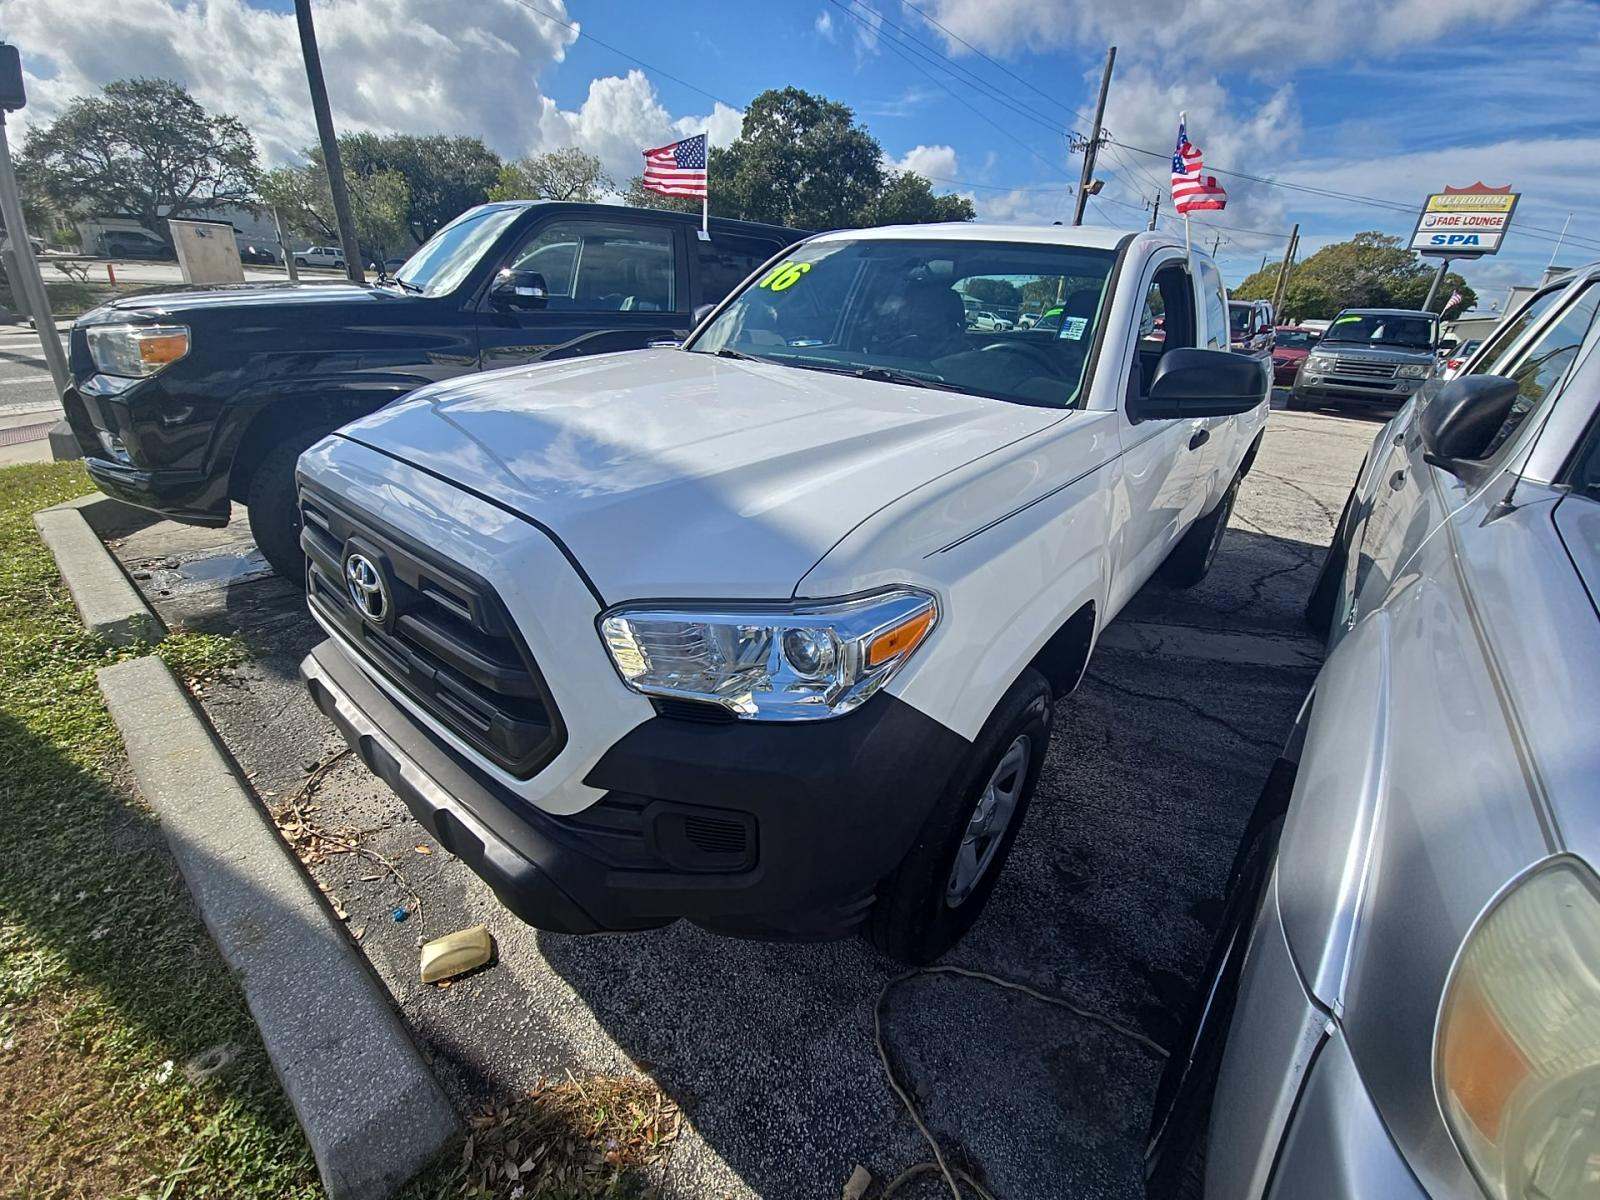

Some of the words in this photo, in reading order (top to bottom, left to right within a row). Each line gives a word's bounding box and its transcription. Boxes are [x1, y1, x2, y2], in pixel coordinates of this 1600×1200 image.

[1436, 216, 1461, 226] FADE
[1462, 216, 1504, 226] LOUNGE
[1430, 234, 1480, 246] SPA
[759, 262, 811, 292] 16
